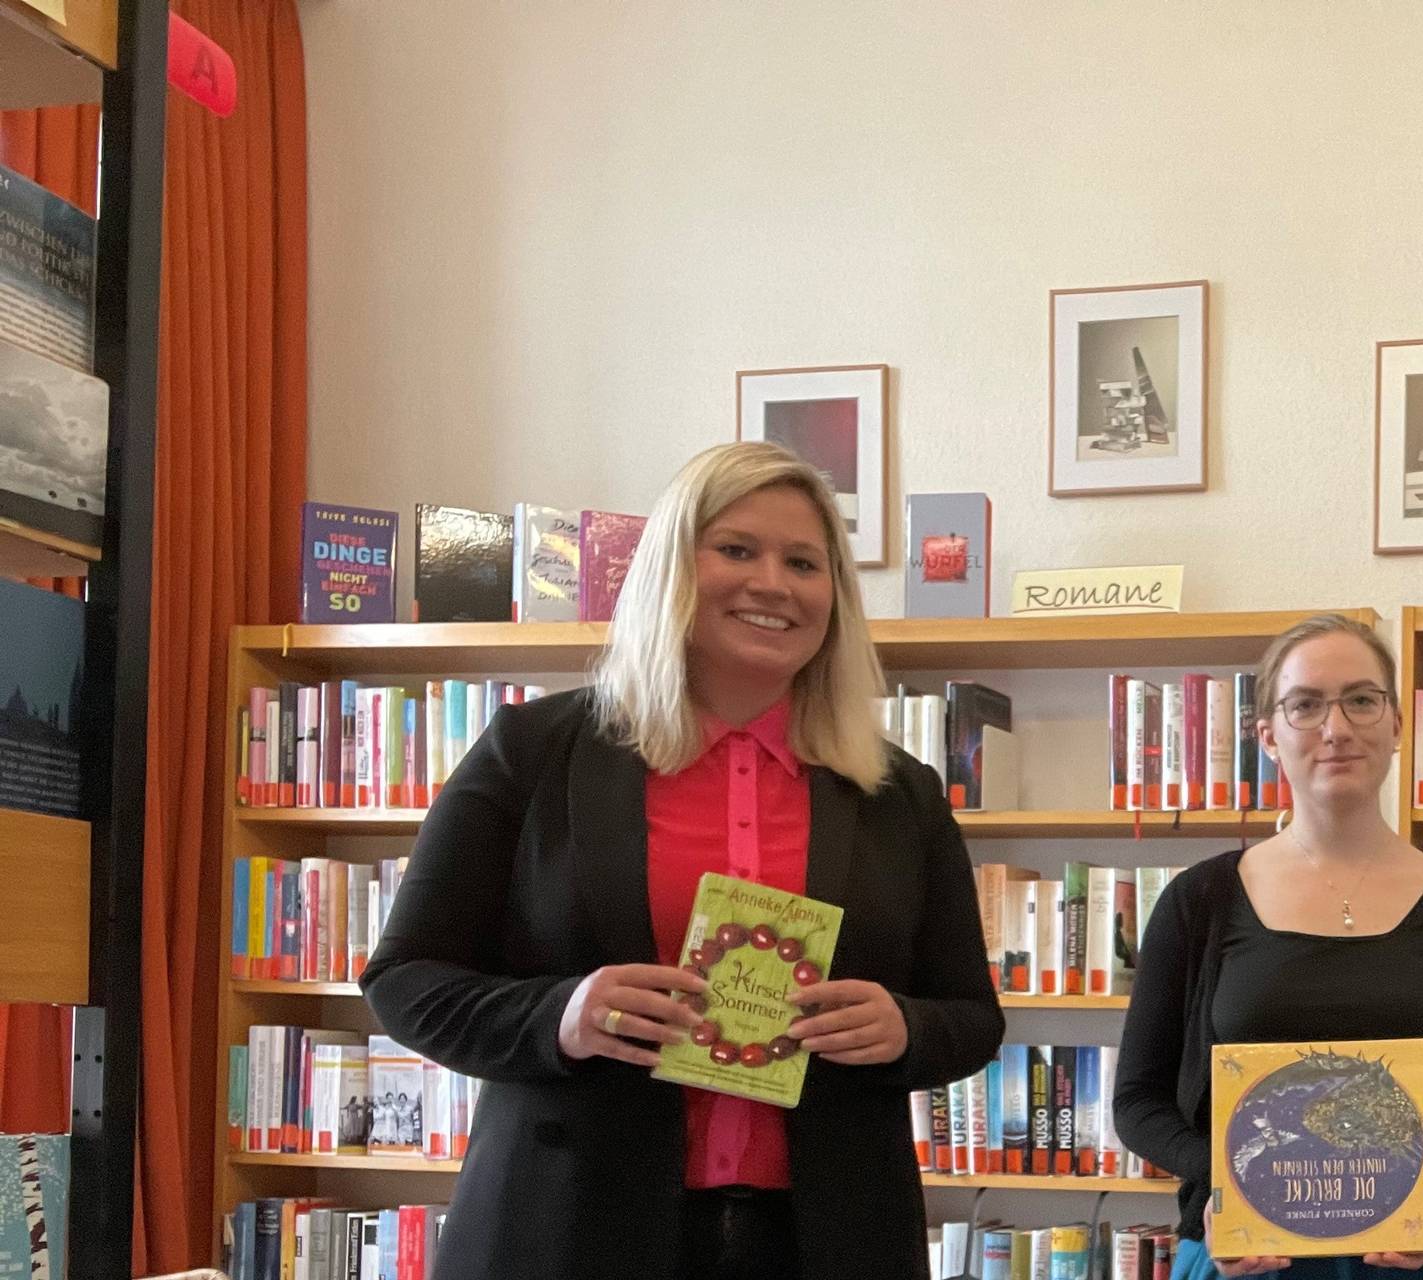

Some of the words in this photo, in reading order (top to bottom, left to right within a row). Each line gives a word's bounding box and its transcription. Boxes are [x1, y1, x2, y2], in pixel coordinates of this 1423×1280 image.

[313, 541, 388, 566] DINGE
[329, 571, 368, 585] NICHT
[329, 592, 361, 613] SO
[1025, 580, 1163, 609] Romane
[729, 887, 782, 914] Anneke
[712, 981, 785, 1021] Sommer
[953, 1084, 965, 1144] URAKA
[1036, 1108, 1049, 1149] MUSSO
[1060, 1108, 1072, 1149] MUSSO
[1323, 1159, 1344, 1175] DEN
[1284, 1178, 1342, 1206] BRÜCKE
[1353, 1176, 1375, 1201] DIE
[1286, 1210, 1320, 1219] FUNKE
[1324, 1208, 1375, 1218] CORNELIA
